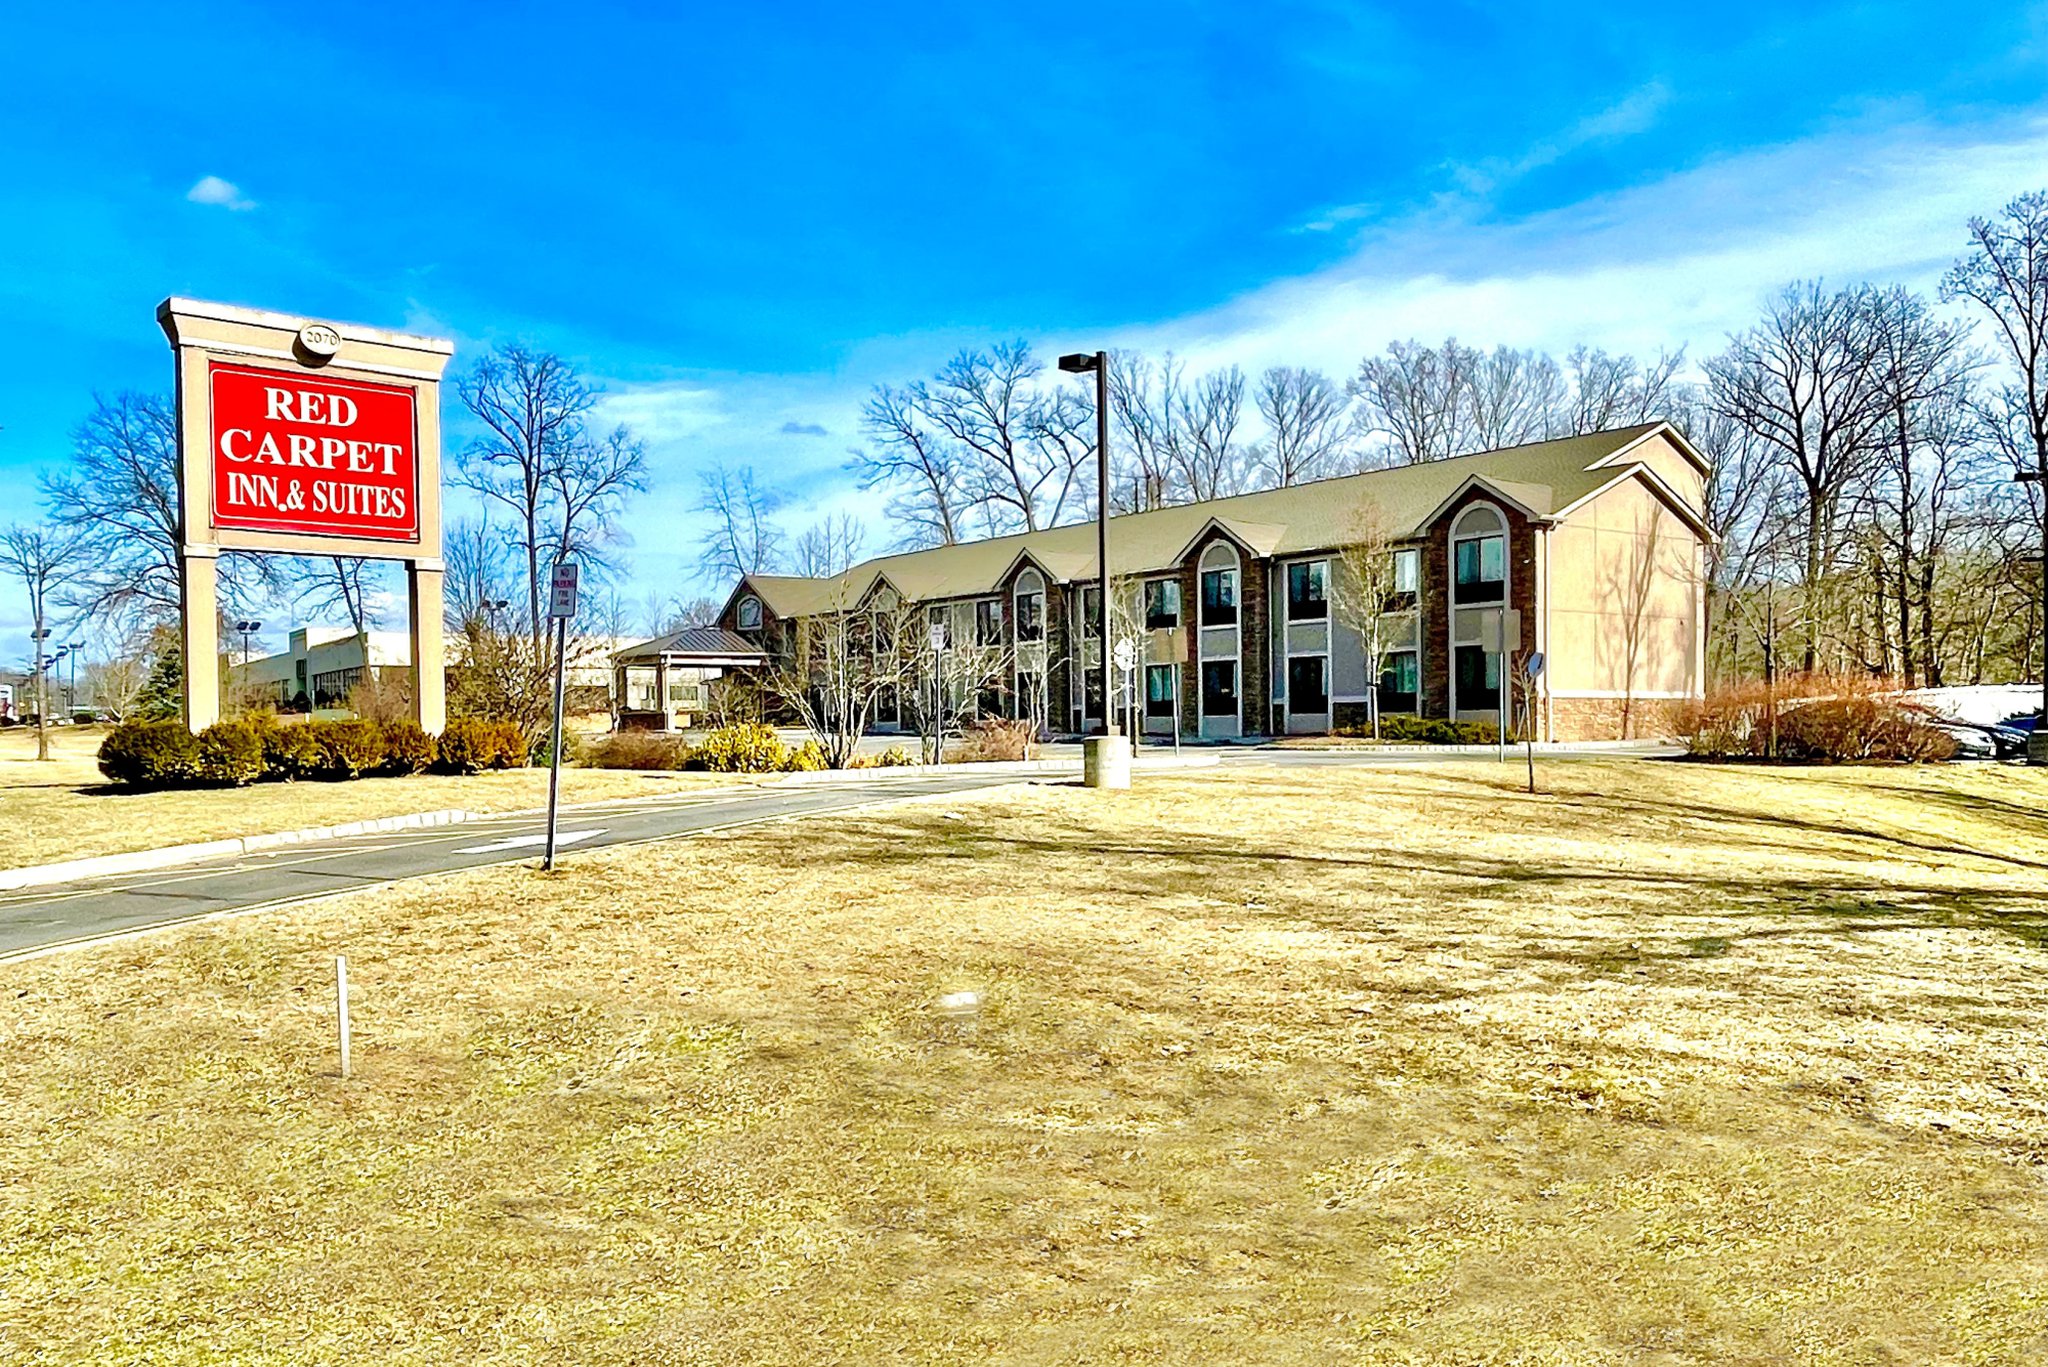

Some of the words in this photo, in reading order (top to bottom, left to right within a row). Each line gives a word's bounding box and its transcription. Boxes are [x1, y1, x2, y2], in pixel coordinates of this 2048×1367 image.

[306, 331, 338, 346] 2070
[264, 387, 358, 427] RED
[220, 428, 403, 475] CARPET
[312, 479, 406, 519] SUITES
